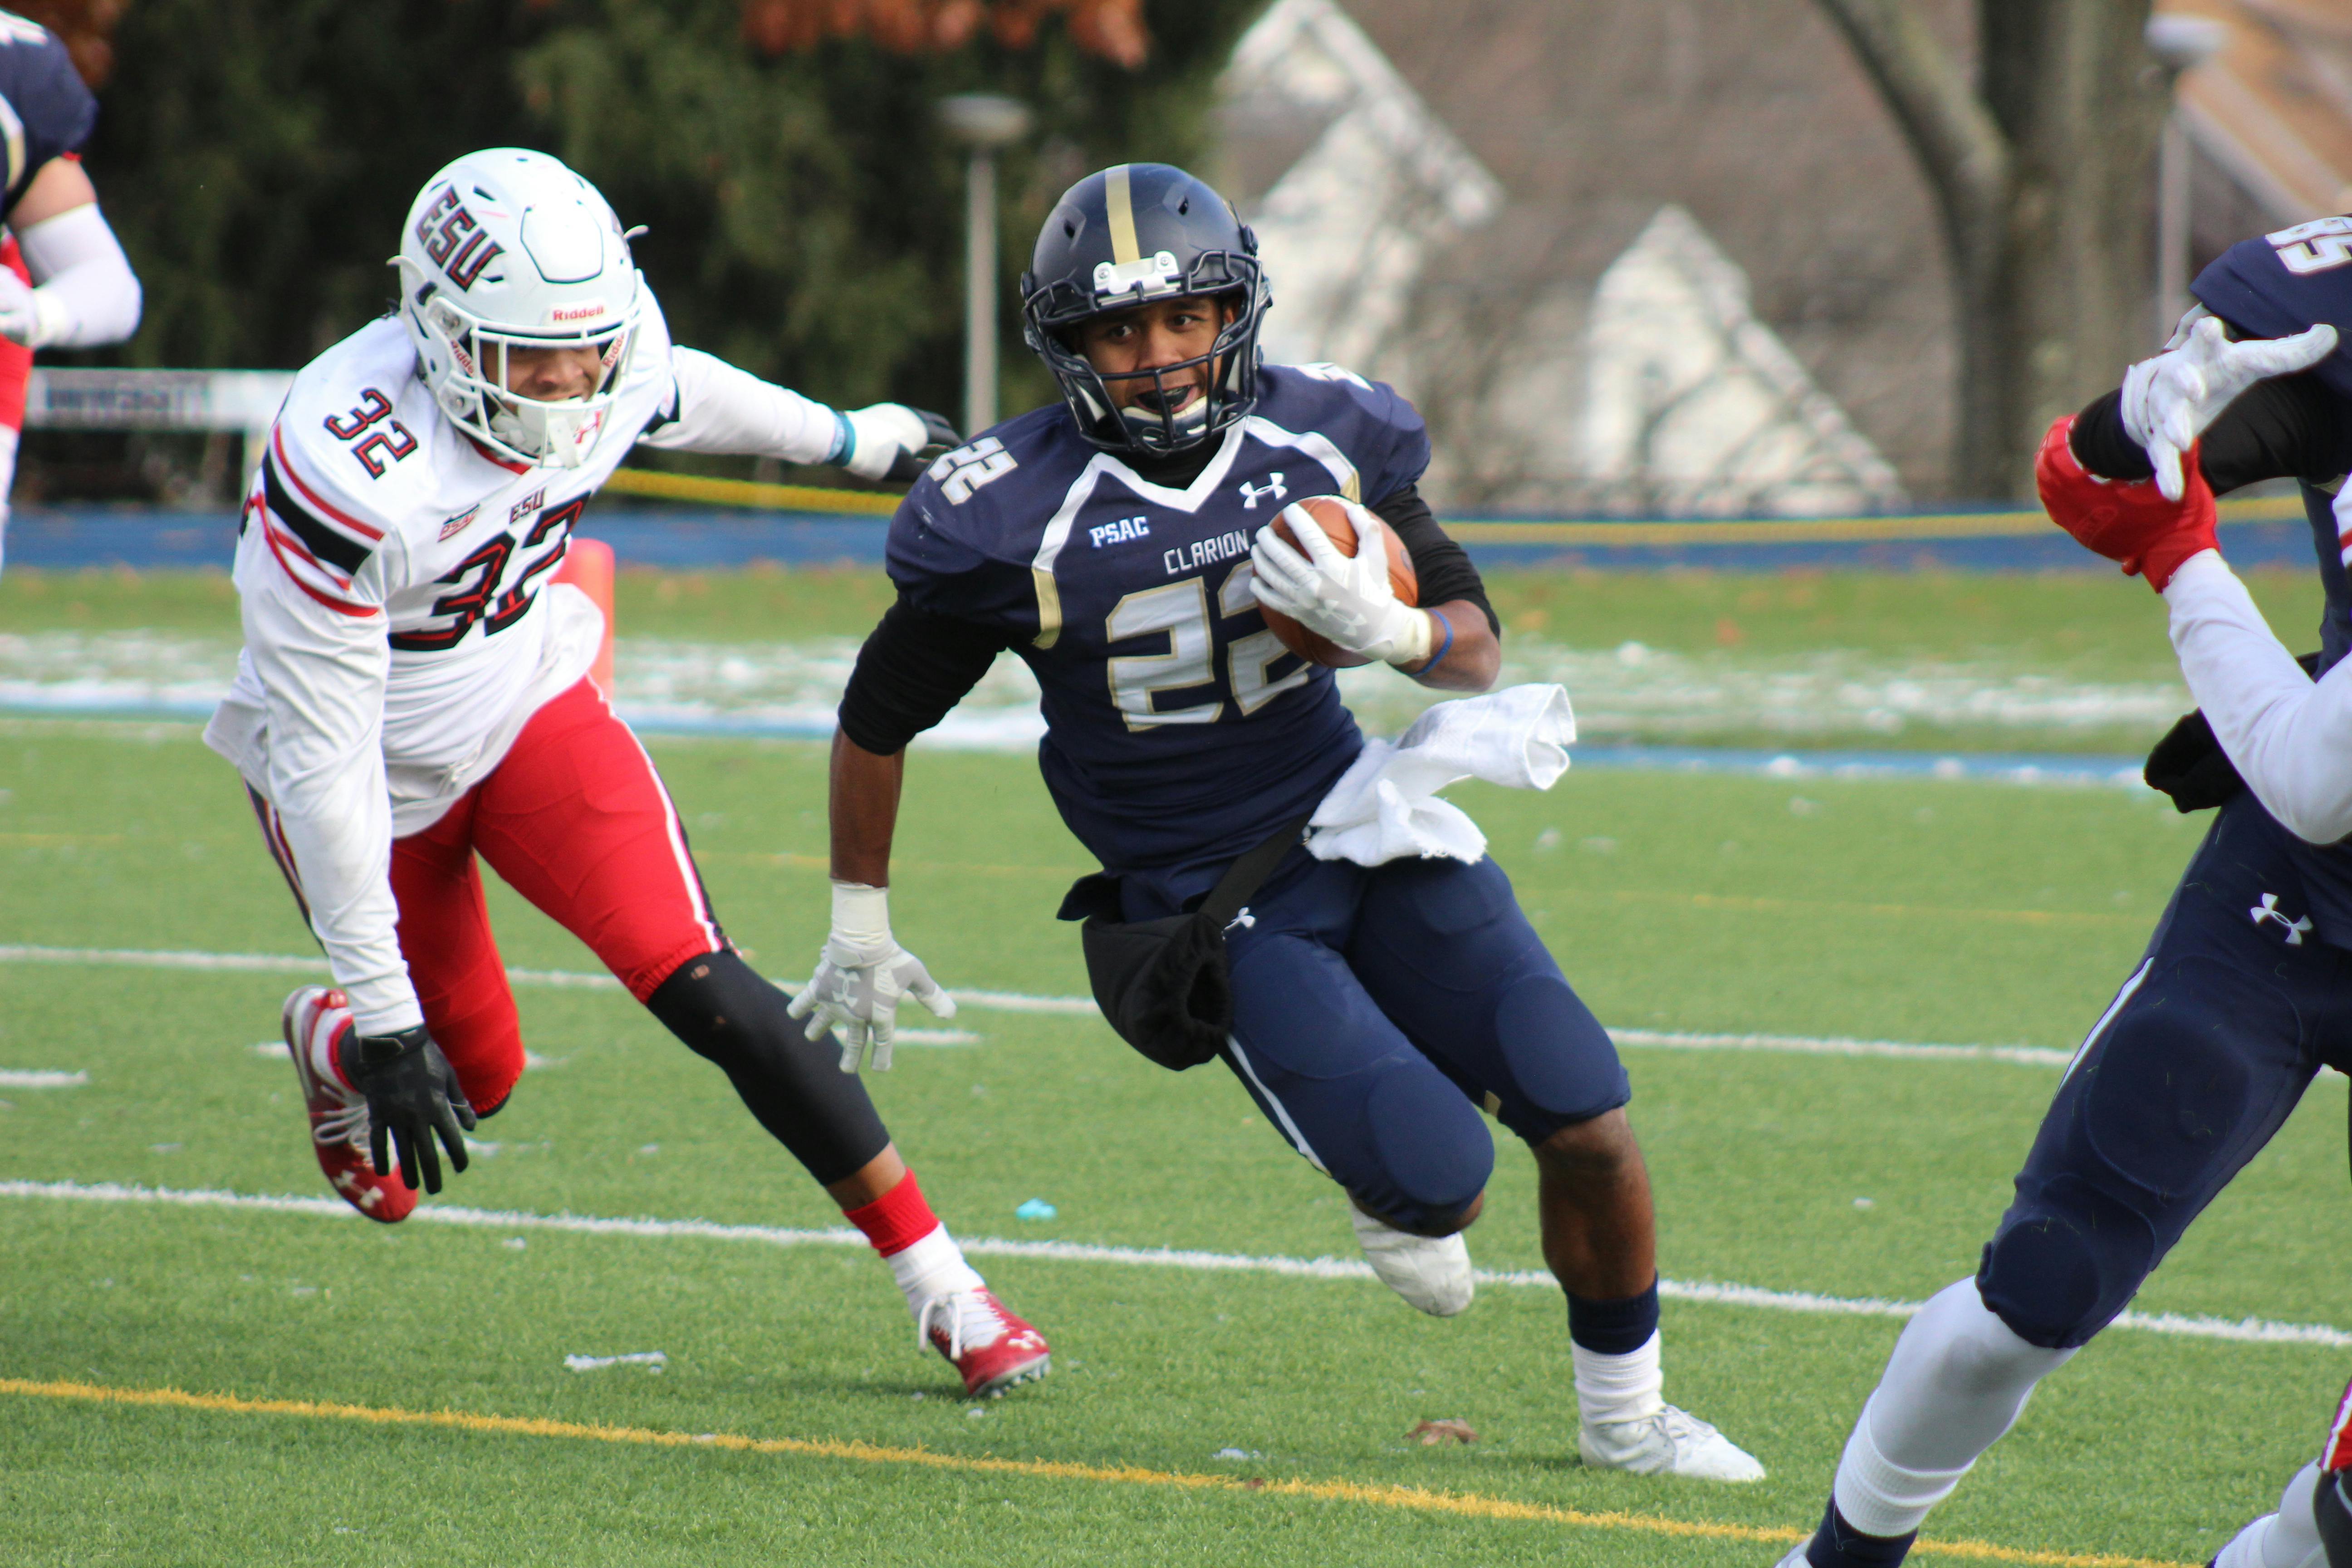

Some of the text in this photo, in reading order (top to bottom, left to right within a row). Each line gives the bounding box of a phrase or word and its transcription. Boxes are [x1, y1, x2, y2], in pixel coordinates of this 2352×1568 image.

[416, 182, 506, 293] ESU
[552, 304, 604, 321] Riddell
[602, 332, 624, 368] Ridd
[323, 388, 418, 480] 32
[927, 436, 1018, 506] 22
[509, 485, 546, 524] ESU
[1088, 515, 1150, 548] PSAC
[387, 490, 591, 652] 32
[1163, 528, 1250, 575] CLARION
[1105, 559, 1314, 732] 22
